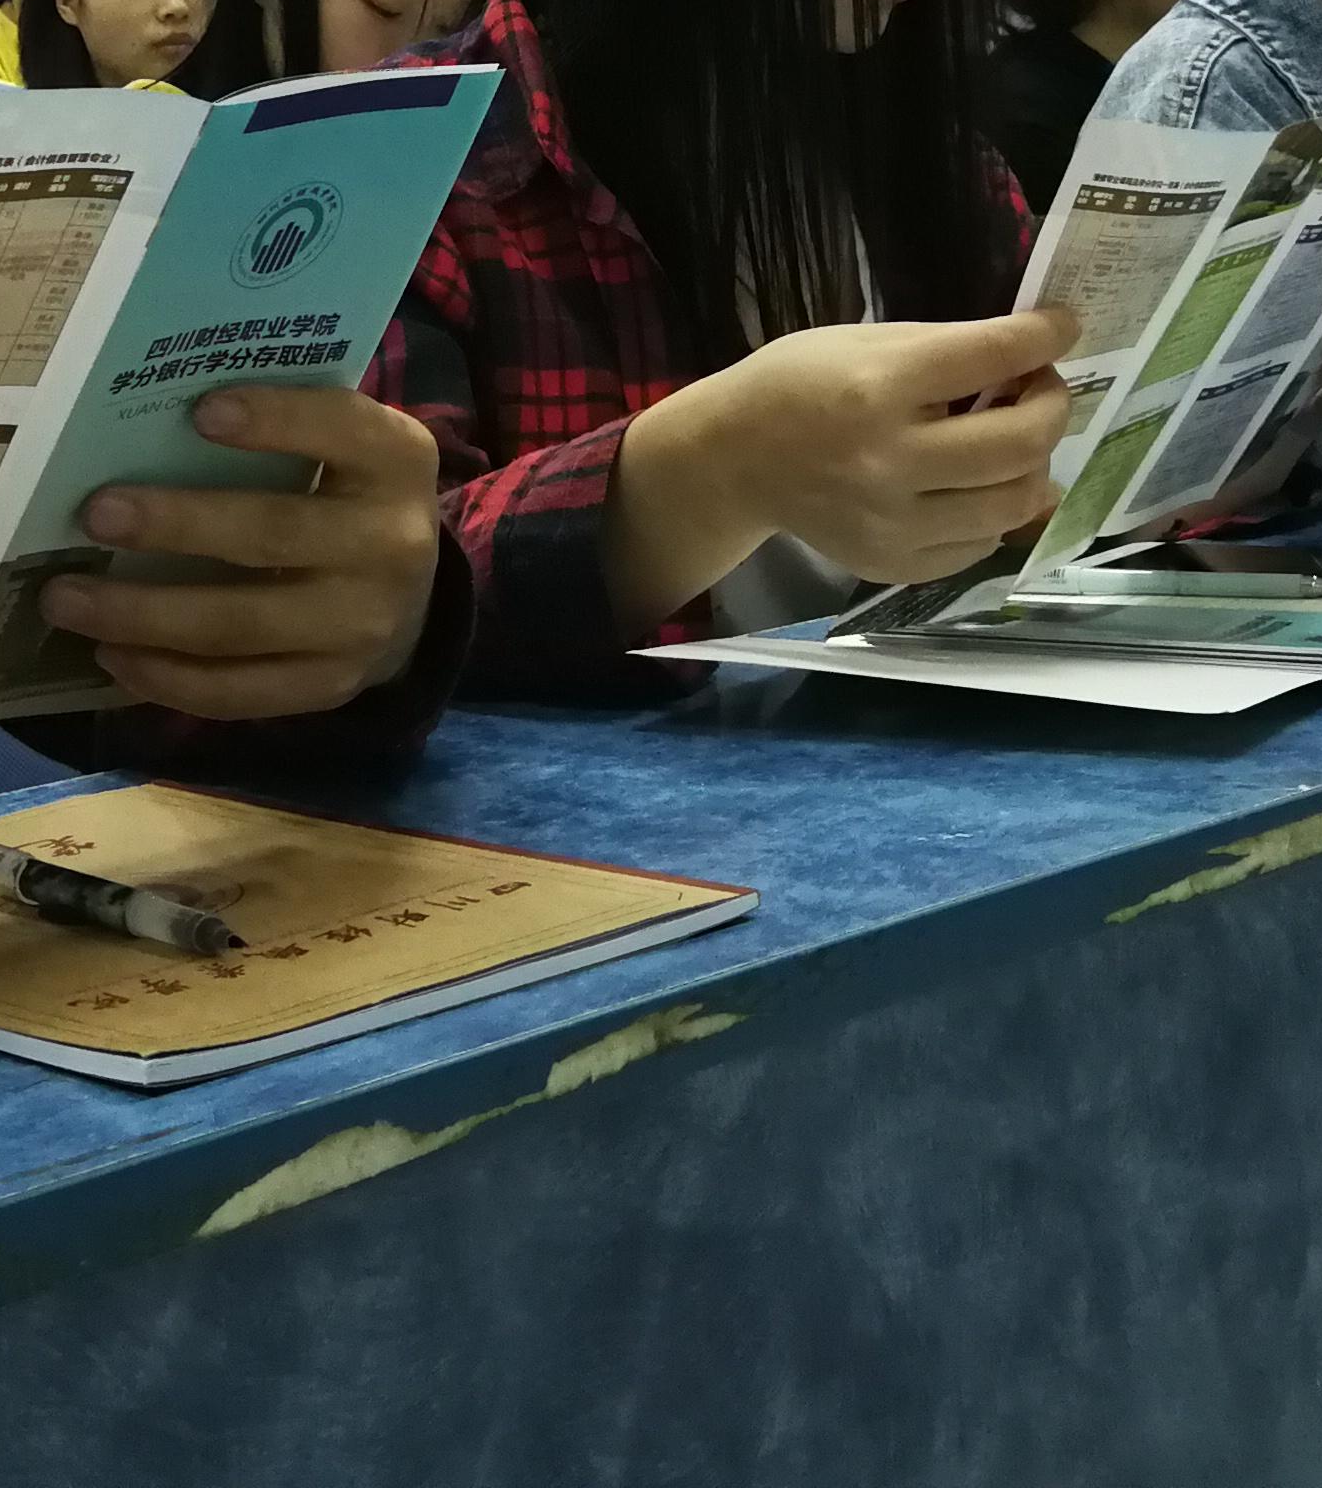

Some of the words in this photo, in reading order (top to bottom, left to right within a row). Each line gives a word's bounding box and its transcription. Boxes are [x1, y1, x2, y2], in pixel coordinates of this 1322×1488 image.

[144, 313, 341, 362] 四川财经职业学院
[109, 339, 353, 395] 学分银行学分存取指南
